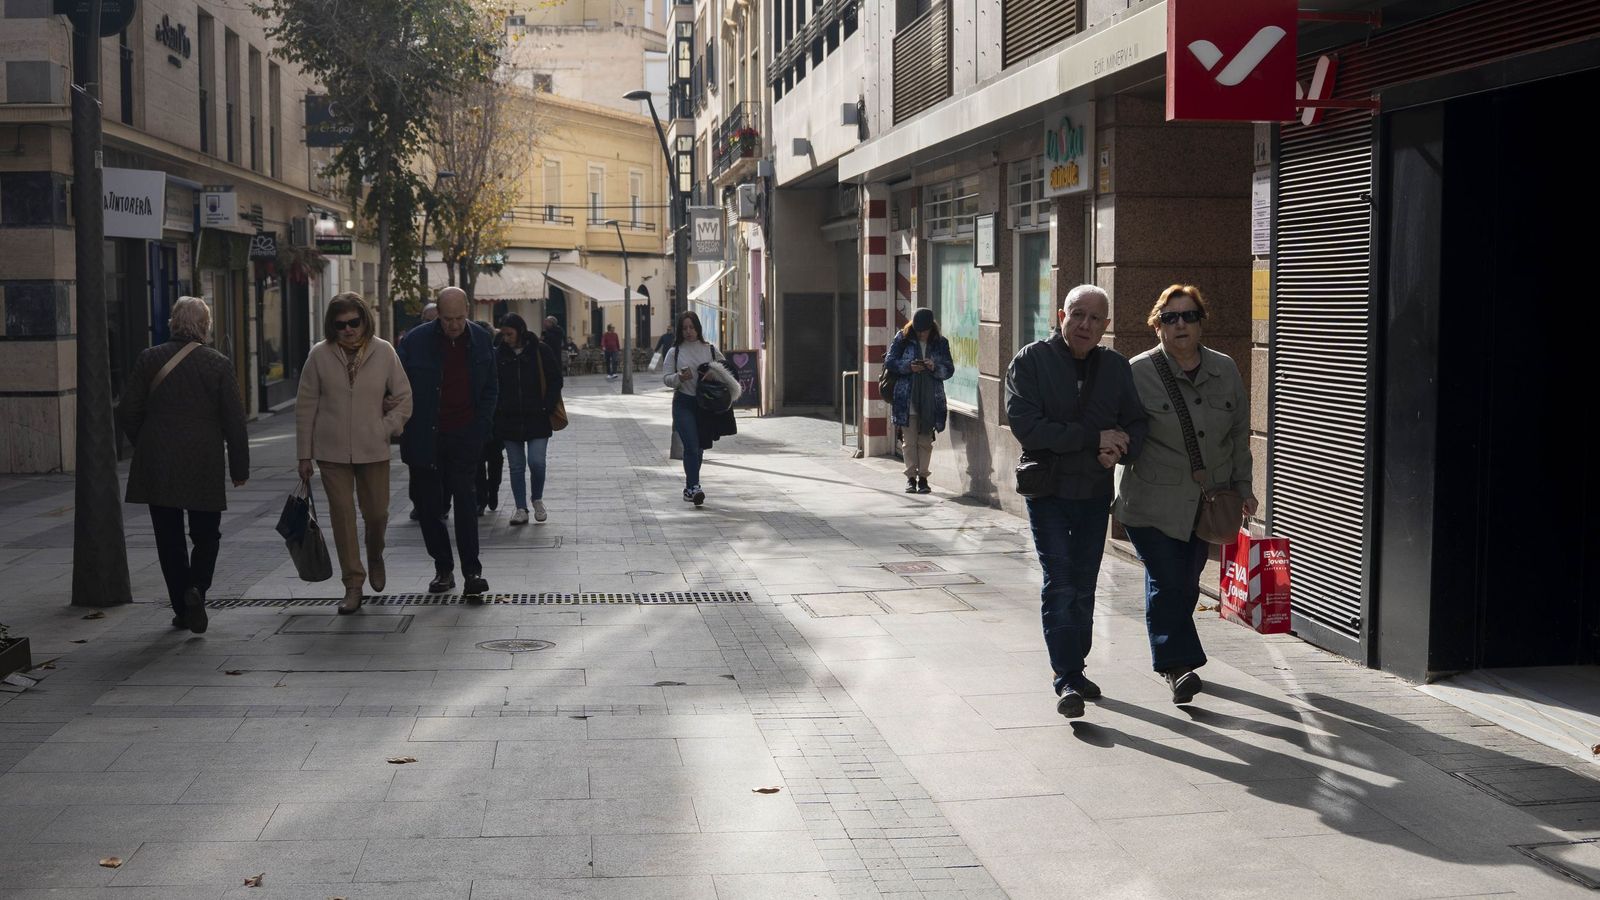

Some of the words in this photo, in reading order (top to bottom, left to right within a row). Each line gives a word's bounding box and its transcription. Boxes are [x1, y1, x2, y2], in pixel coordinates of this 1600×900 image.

[1256, 142, 1266, 161] 14
[1263, 550, 1286, 558] EVA
[1225, 560, 1248, 585] EVA
